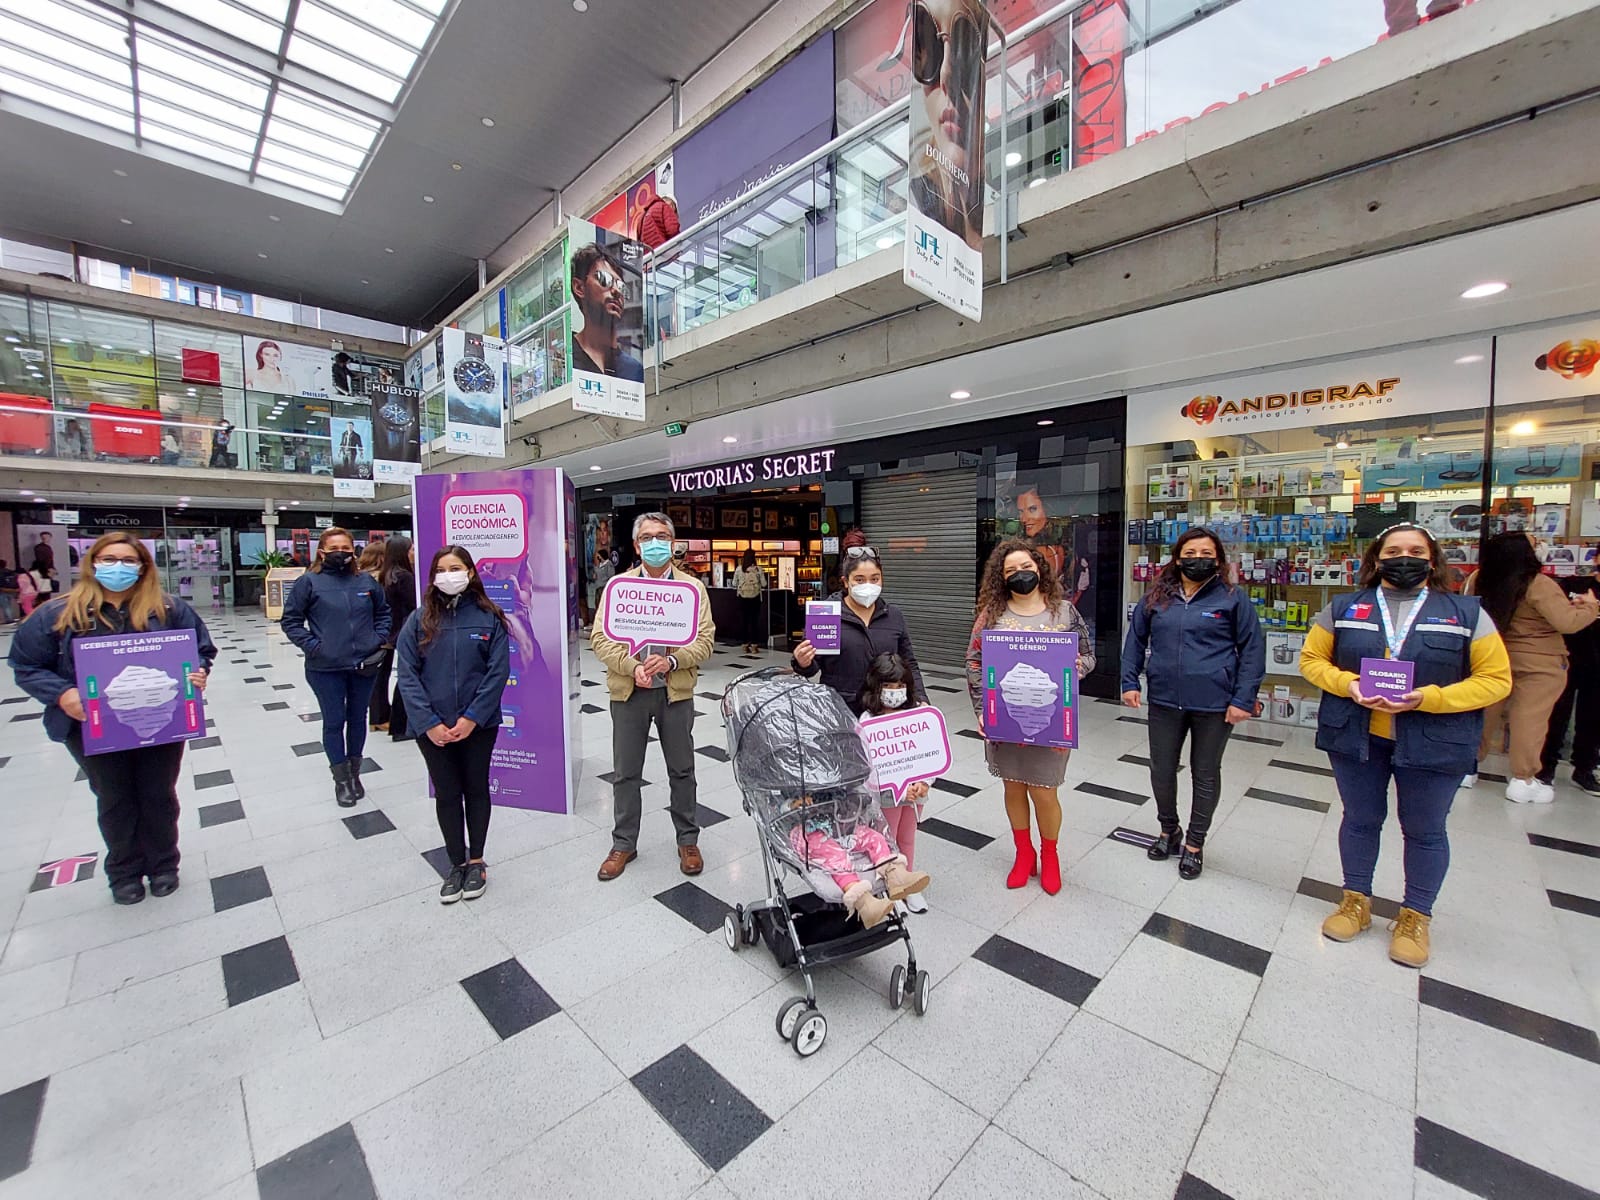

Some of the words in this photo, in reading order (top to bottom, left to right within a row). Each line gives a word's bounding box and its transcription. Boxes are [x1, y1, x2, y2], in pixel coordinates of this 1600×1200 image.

[372, 383, 419, 398] HUBLOT
[669, 463, 755, 493] VICTORIA'S
[762, 449, 836, 481] SECRET
[450, 503, 506, 515] VIOLENCIA
[451, 516, 517, 529] ECONÓMICA
[617, 589, 683, 604] VIOLENCIA
[616, 603, 665, 616] OCULTA
[80, 641, 119, 650] ICEBERG
[145, 634, 190, 644] VIOLENCIA
[1034, 637, 1072, 645] VIOLENCIA
[113, 647, 126, 655] DE
[1368, 670, 1407, 679] GLOSARIO
[866, 721, 930, 744] VIOLENCIA
[869, 739, 917, 759] OCULTA
